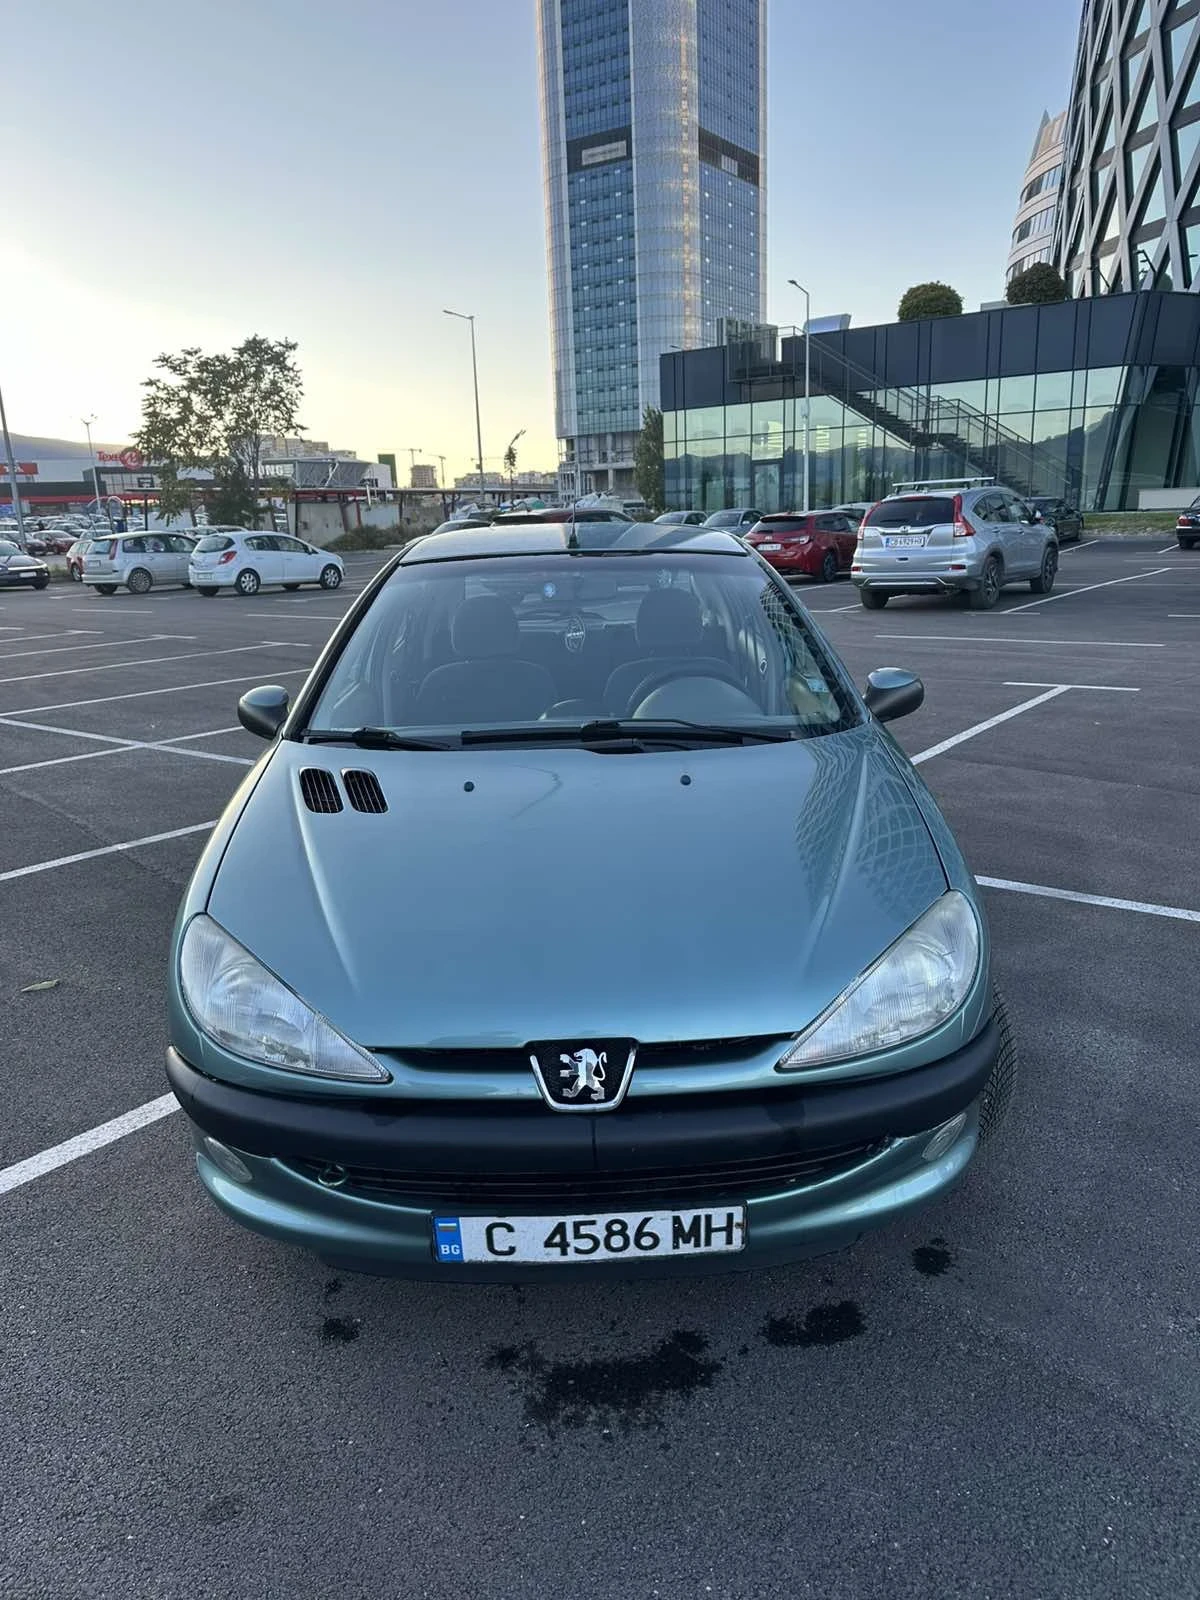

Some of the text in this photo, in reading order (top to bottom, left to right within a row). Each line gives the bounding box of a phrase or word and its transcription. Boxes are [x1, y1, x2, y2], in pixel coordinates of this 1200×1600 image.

[485, 1212, 735, 1257] C 4586 MH
[441, 1244, 460, 1255] BG
